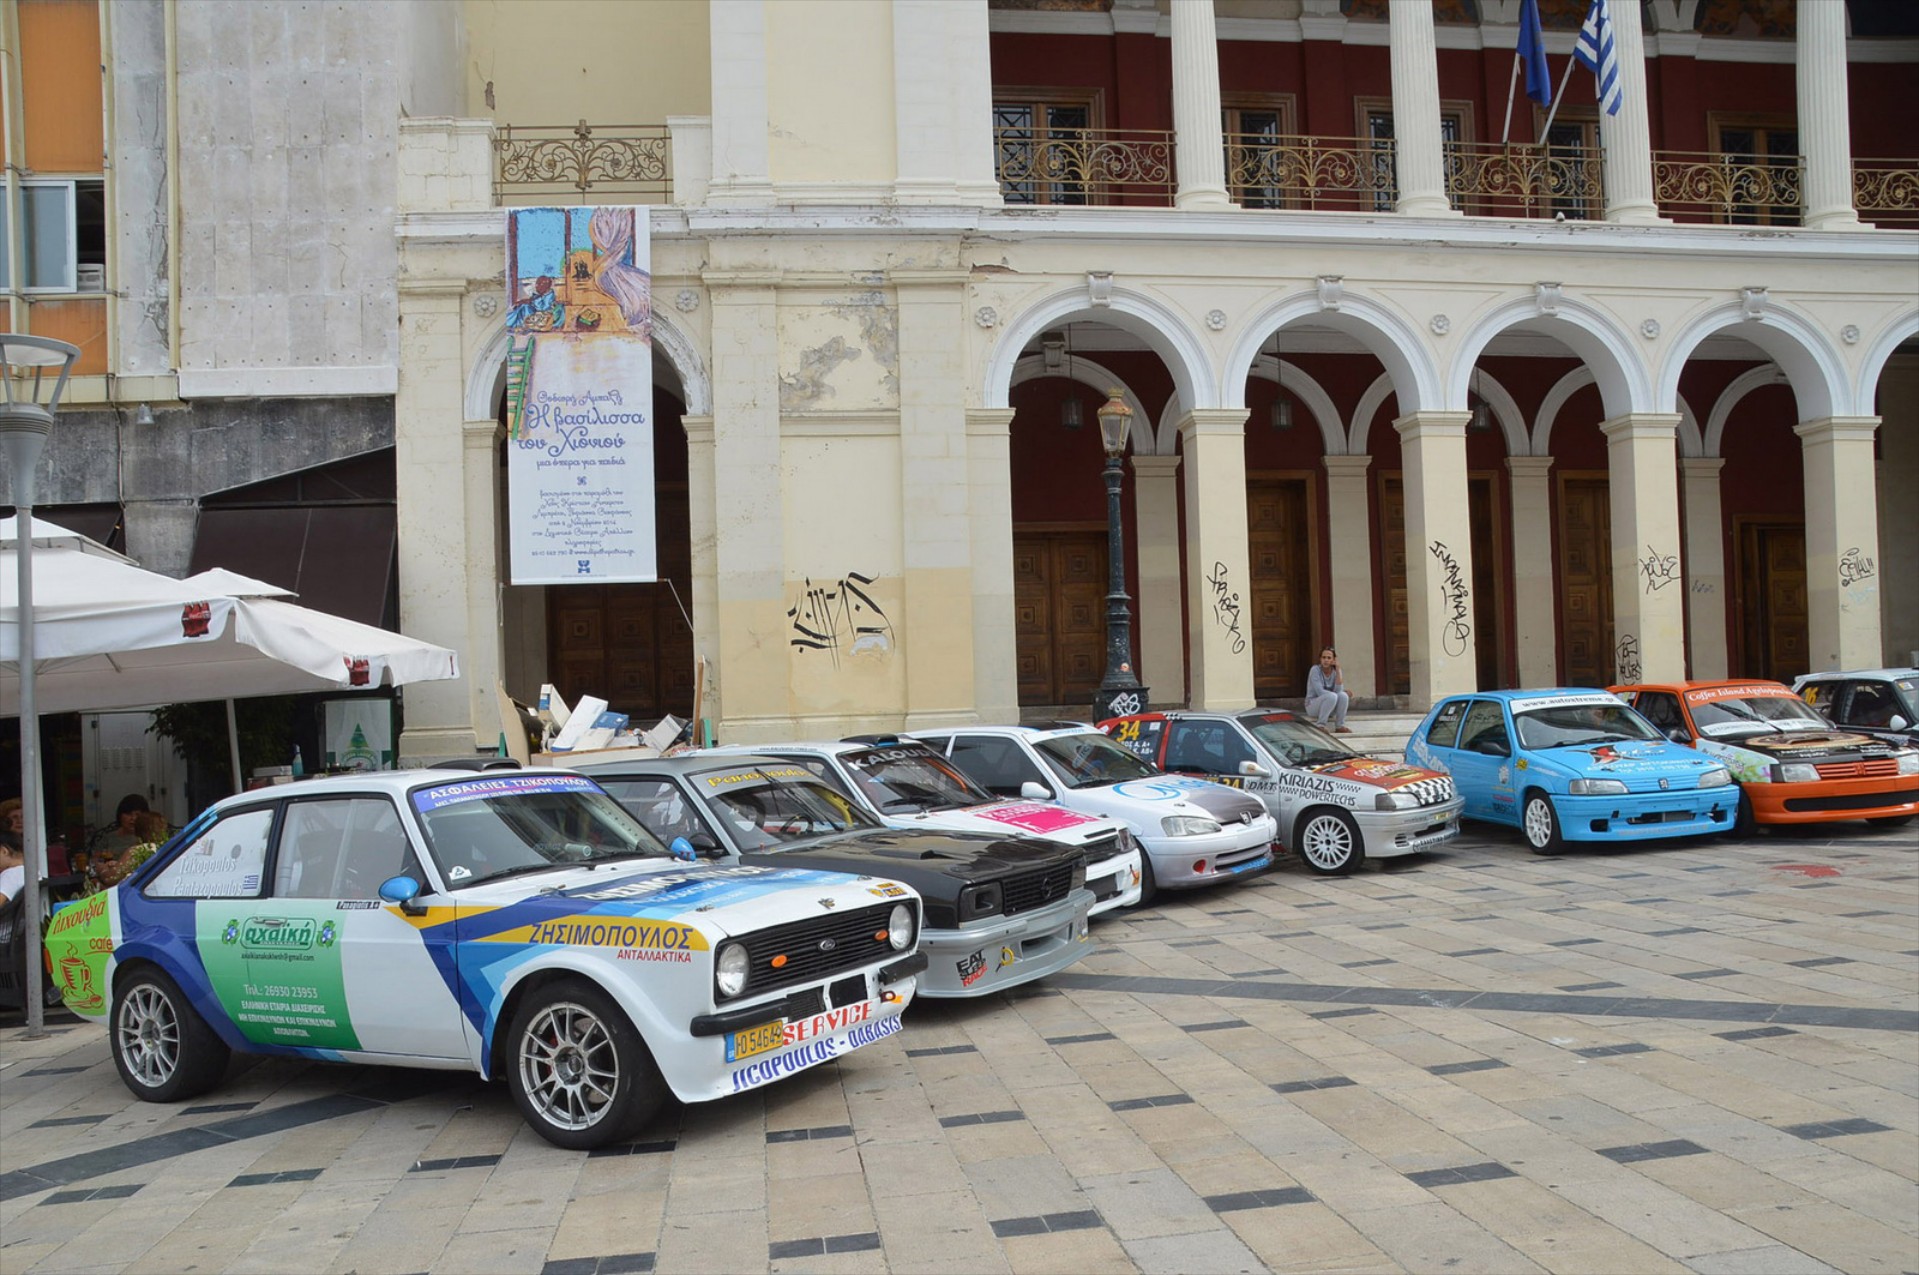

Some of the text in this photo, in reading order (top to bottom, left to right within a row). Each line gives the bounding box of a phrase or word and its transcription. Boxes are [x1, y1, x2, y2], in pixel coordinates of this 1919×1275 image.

[526, 404, 645, 433] Η βασίλισσα
[517, 426, 626, 457] του Χιονιού
[537, 456, 626, 470] μια όπερα για παιδιά
[1688, 690, 1716, 701] Coffee
[1719, 687, 1745, 697] Island
[1804, 687, 1819, 706] 16
[1116, 720, 1141, 742] 34
[430, 781, 507, 800] ΑΣΦΑΛΕΙΕΣ
[510, 777, 590, 788] ΤΖΙΚΟΠΟΥΛΟΥ
[1279, 772, 1335, 793] KIRIAZIS
[1300, 789, 1356, 806] POWERTECHS
[246, 921, 312, 945] αχαϊκή
[529, 923, 694, 949] ΖΗΣΙΜΟΠΟΥΛΟΣ
[617, 949, 692, 963] ΑΝΤΑΛΛΑΚΤΙΚΑ
[956, 948, 985, 974] EAT
[264, 985, 290, 997] 26930
[291, 986, 318, 998] 23953
[783, 1001, 873, 1046] SERVICE
